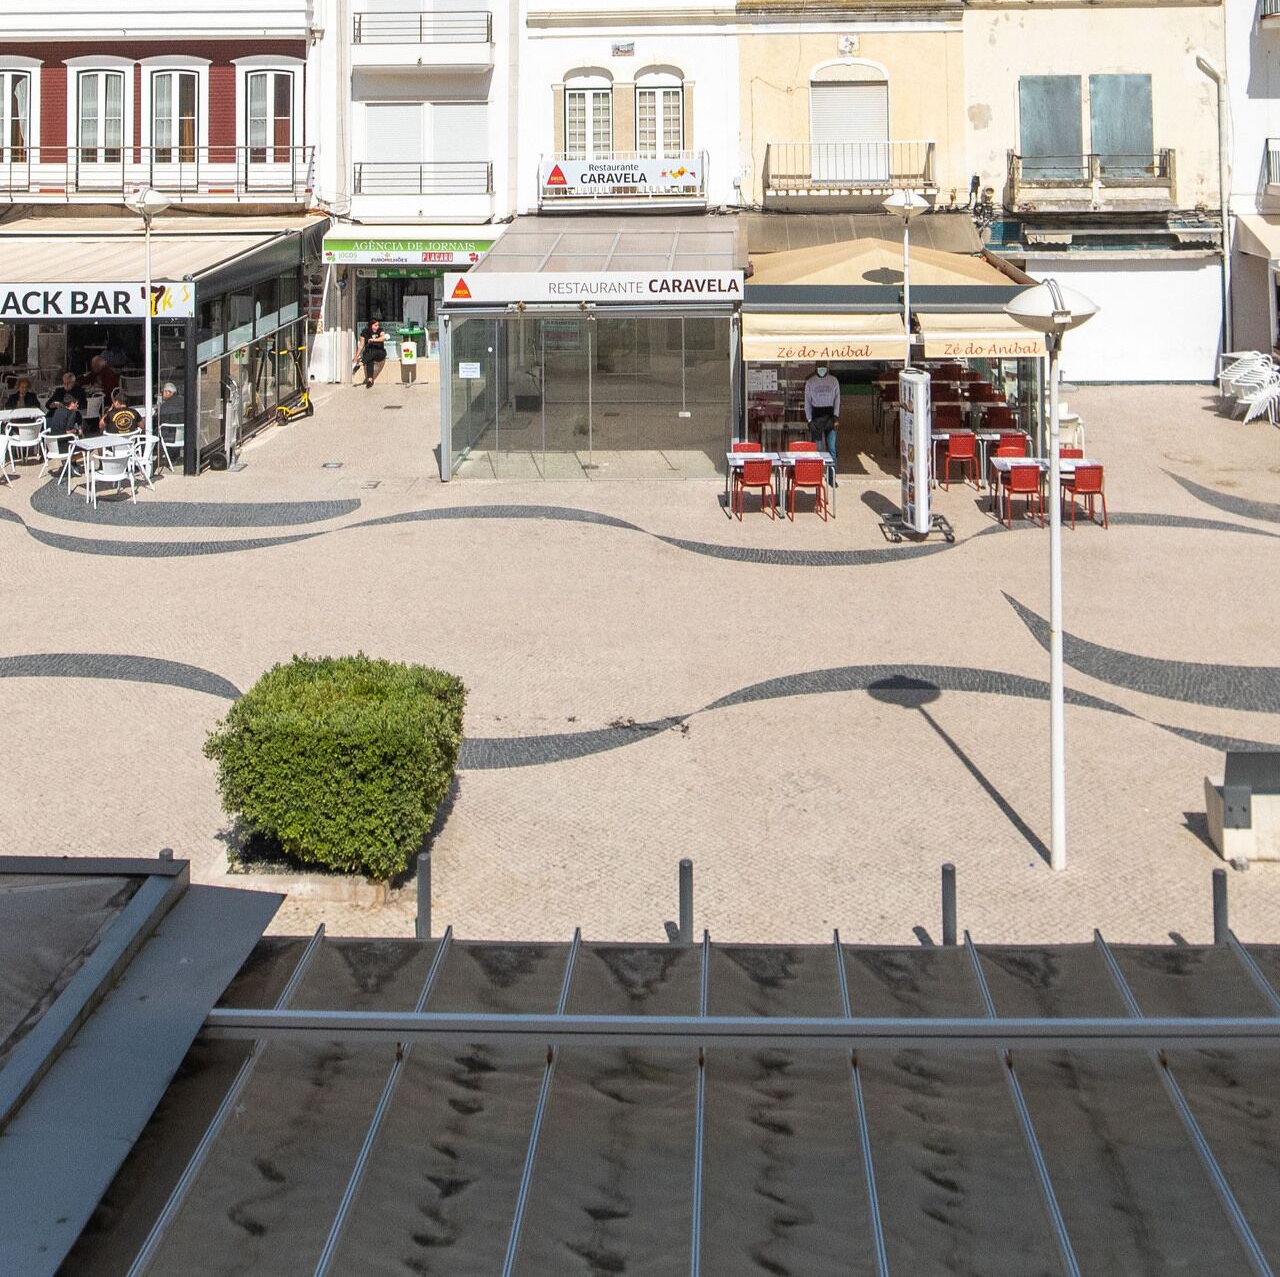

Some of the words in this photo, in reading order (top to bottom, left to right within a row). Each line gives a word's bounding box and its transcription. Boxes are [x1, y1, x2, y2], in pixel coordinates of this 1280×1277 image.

[588, 163, 639, 172] Restaurante
[580, 172, 647, 184] CARAVELA
[352, 240, 404, 251] AGÊNCIA
[407, 241, 422, 251] DE
[426, 241, 476, 251] JORNAIS
[548, 282, 644, 294] RESTAURANTE
[648, 278, 740, 293] CARAVELA
[70, 290, 132, 315] BAR
[776, 346, 795, 359] Zé
[797, 344, 818, 358] do
[821, 344, 873, 358] Anibal
[944, 343, 962, 356] Zé
[964, 341, 985, 355] do
[987, 341, 1041, 356] Anibal
